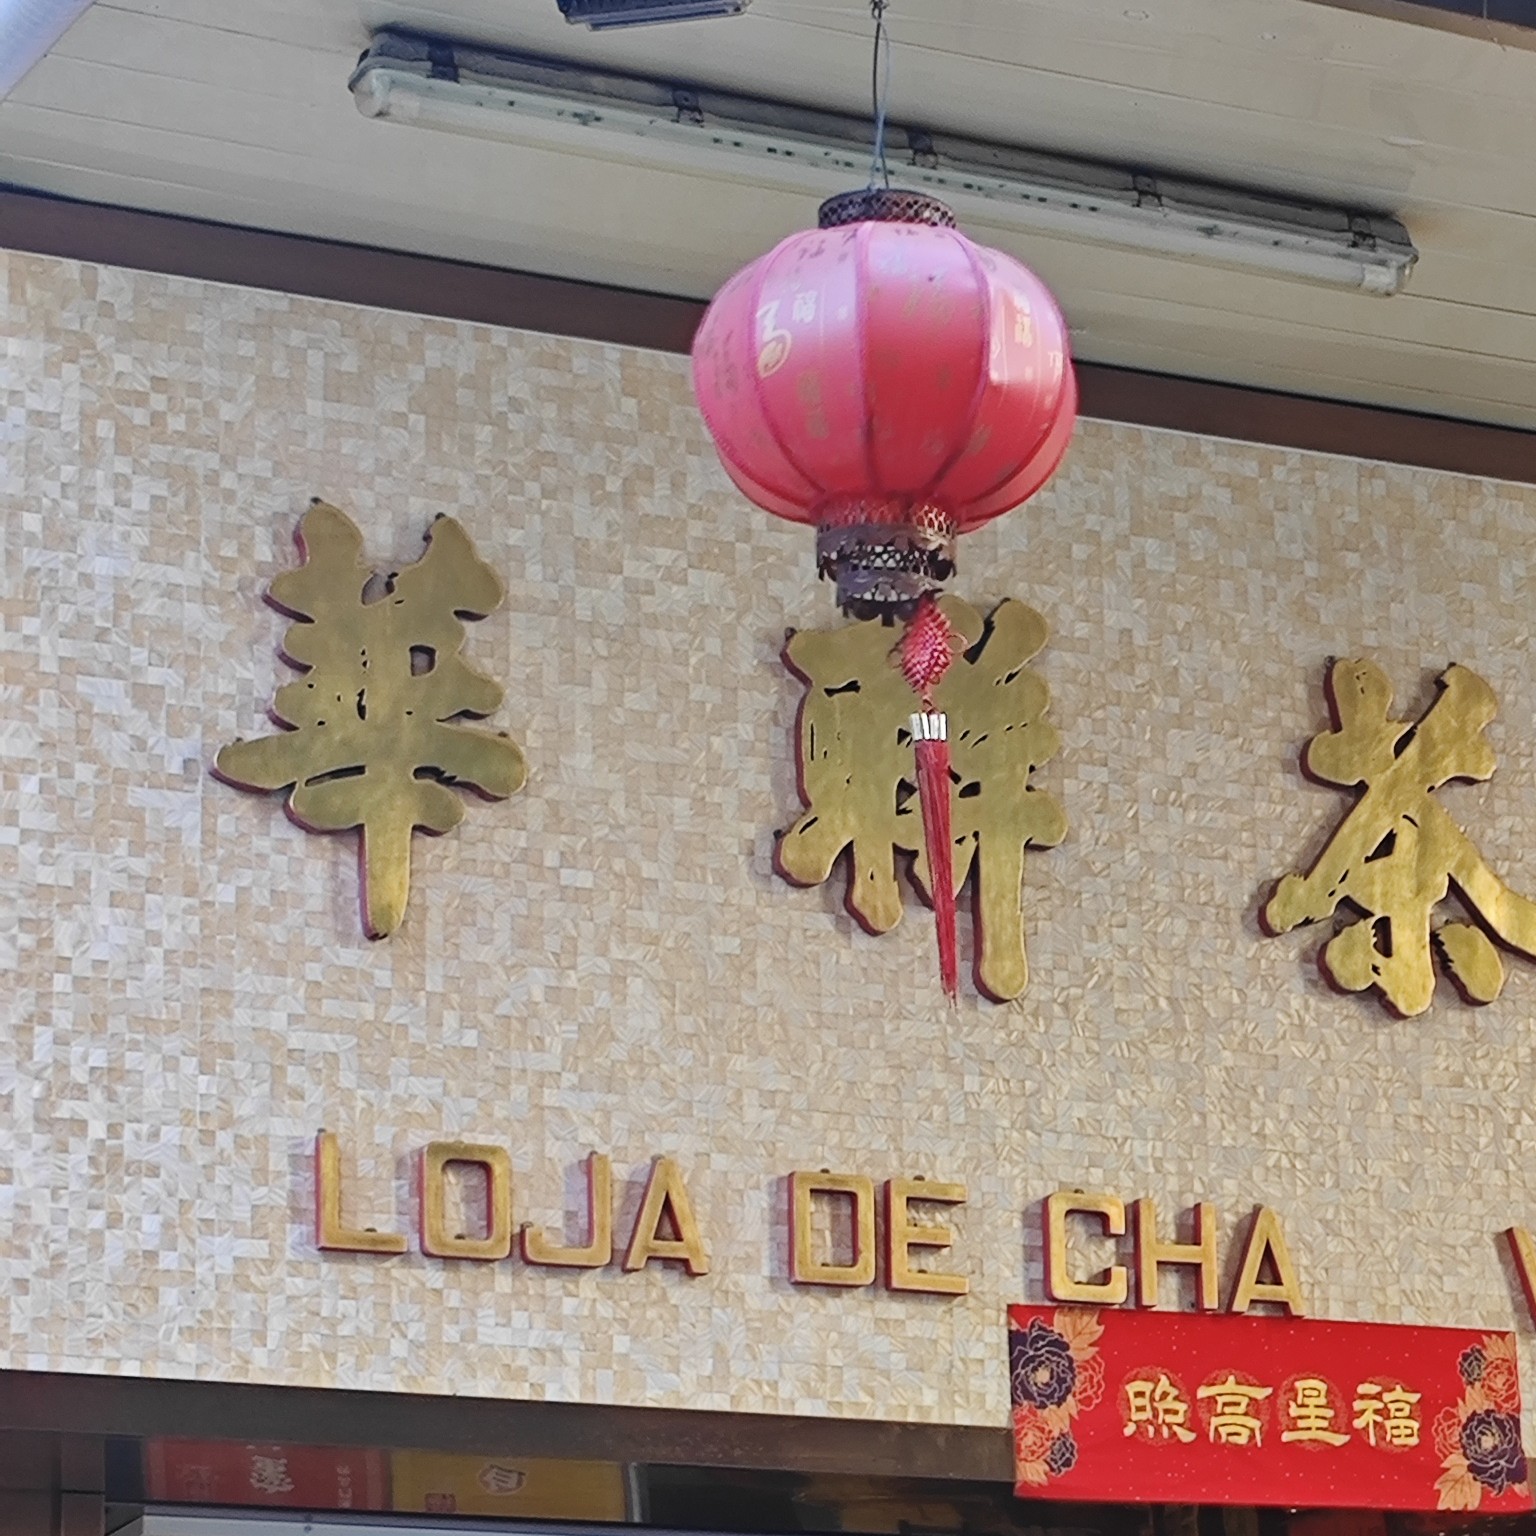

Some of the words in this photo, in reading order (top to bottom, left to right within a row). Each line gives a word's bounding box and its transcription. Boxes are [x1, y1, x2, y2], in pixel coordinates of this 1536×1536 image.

[314, 1128, 710, 1277] LOJA
[787, 1169, 970, 1296] DE
[1042, 1188, 1307, 1318] CHA
